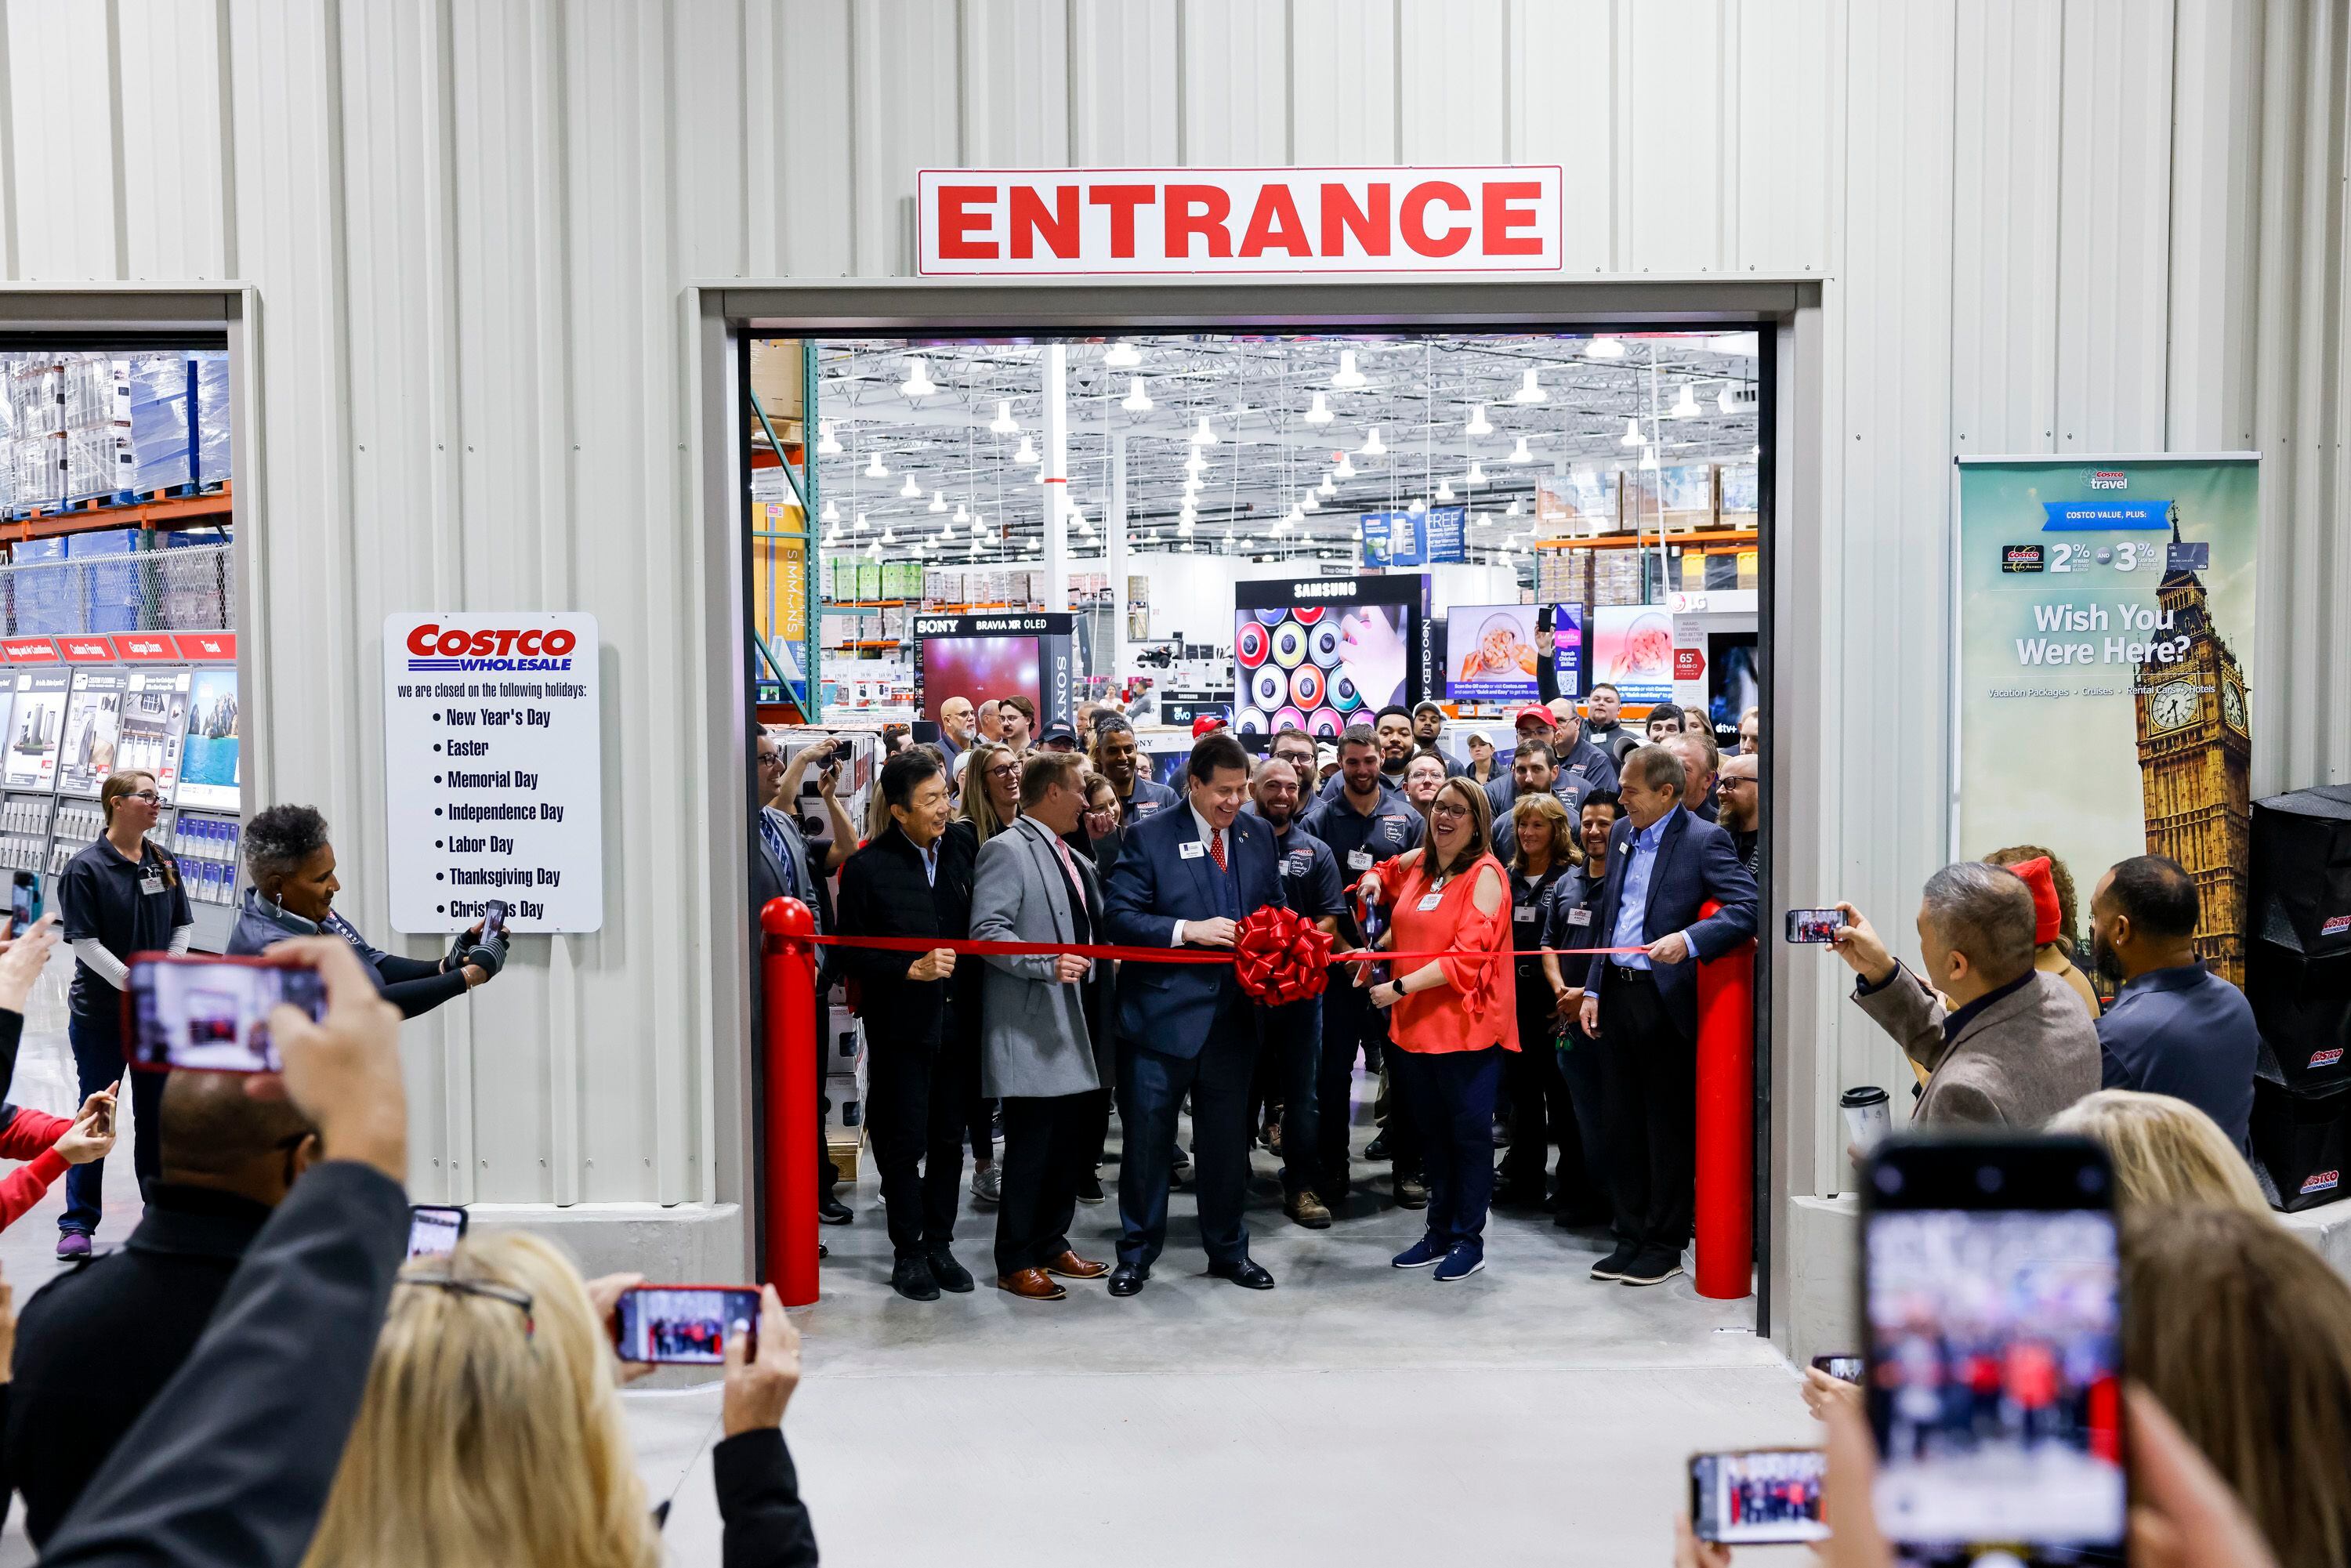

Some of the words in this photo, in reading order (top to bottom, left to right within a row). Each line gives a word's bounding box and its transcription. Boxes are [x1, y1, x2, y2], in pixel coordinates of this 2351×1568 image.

[937, 181, 1544, 259] ENTRANCE
[2090, 477, 2128, 490] travel
[1425, 512, 1459, 529] FREE
[2097, 511, 2124, 520] VALUE,
[2050, 543, 2091, 573] 2%
[2115, 541, 2154, 571] 3%
[1294, 581, 1357, 598] SAMSUNG
[1688, 595, 1707, 610] LG
[917, 619, 958, 633] SONY
[976, 621, 1007, 630] BRAVIA
[1008, 620, 1021, 629] XR
[1023, 619, 1047, 629] OLED
[2034, 603, 2109, 632] Wish
[2117, 603, 2174, 631] You
[407, 624, 576, 657] COSTCO
[1422, 619, 1431, 647] Neo
[69, 643, 87, 655] Custom
[84, 643, 106, 657] Flooring
[129, 641, 147, 656] Garage
[144, 641, 163, 653] Doors
[200, 640, 221, 653] Travel
[2016, 638, 2095, 665] Were
[2103, 636, 2191, 664] Here?
[459, 659, 571, 671] WHOLESALE
[1422, 649, 1432, 684] QLED
[1679, 653, 1695, 663] 65"
[398, 685, 412, 697] we
[415, 684, 431, 697] are
[435, 683, 465, 697] closed
[469, 684, 479, 697] on
[482, 683, 497, 697] the
[499, 683, 542, 699] following
[545, 682, 587, 699] holidays:
[1056, 656, 1067, 720] SONY
[1987, 689, 2026, 697] Vacation
[2027, 687, 2069, 698] Packages
[2081, 686, 2114, 696] Cruises
[2126, 686, 2154, 694] Rental
[2156, 685, 2175, 694] Cars
[2189, 684, 2215, 693] Hotels
[447, 708, 476, 726] New
[480, 708, 523, 726] Year's
[527, 708, 551, 728] Day
[1174, 711, 1190, 720] evo
[447, 740, 489, 756] Easter
[447, 770, 510, 788] Memorial
[515, 770, 538, 790] Day
[448, 803, 536, 823] Independence
[540, 803, 564, 823] Day
[449, 835, 486, 853] Labor
[490, 835, 513, 855] Day
[449, 867, 533, 888] Thanksgiving
[537, 867, 560, 887] Day
[520, 900, 544, 920] Day
[2311, 1048, 2343, 1063] COSTCO
[2303, 1170, 2338, 1187] COSTCO
[2313, 1181, 2337, 1190] WHOLESALE
